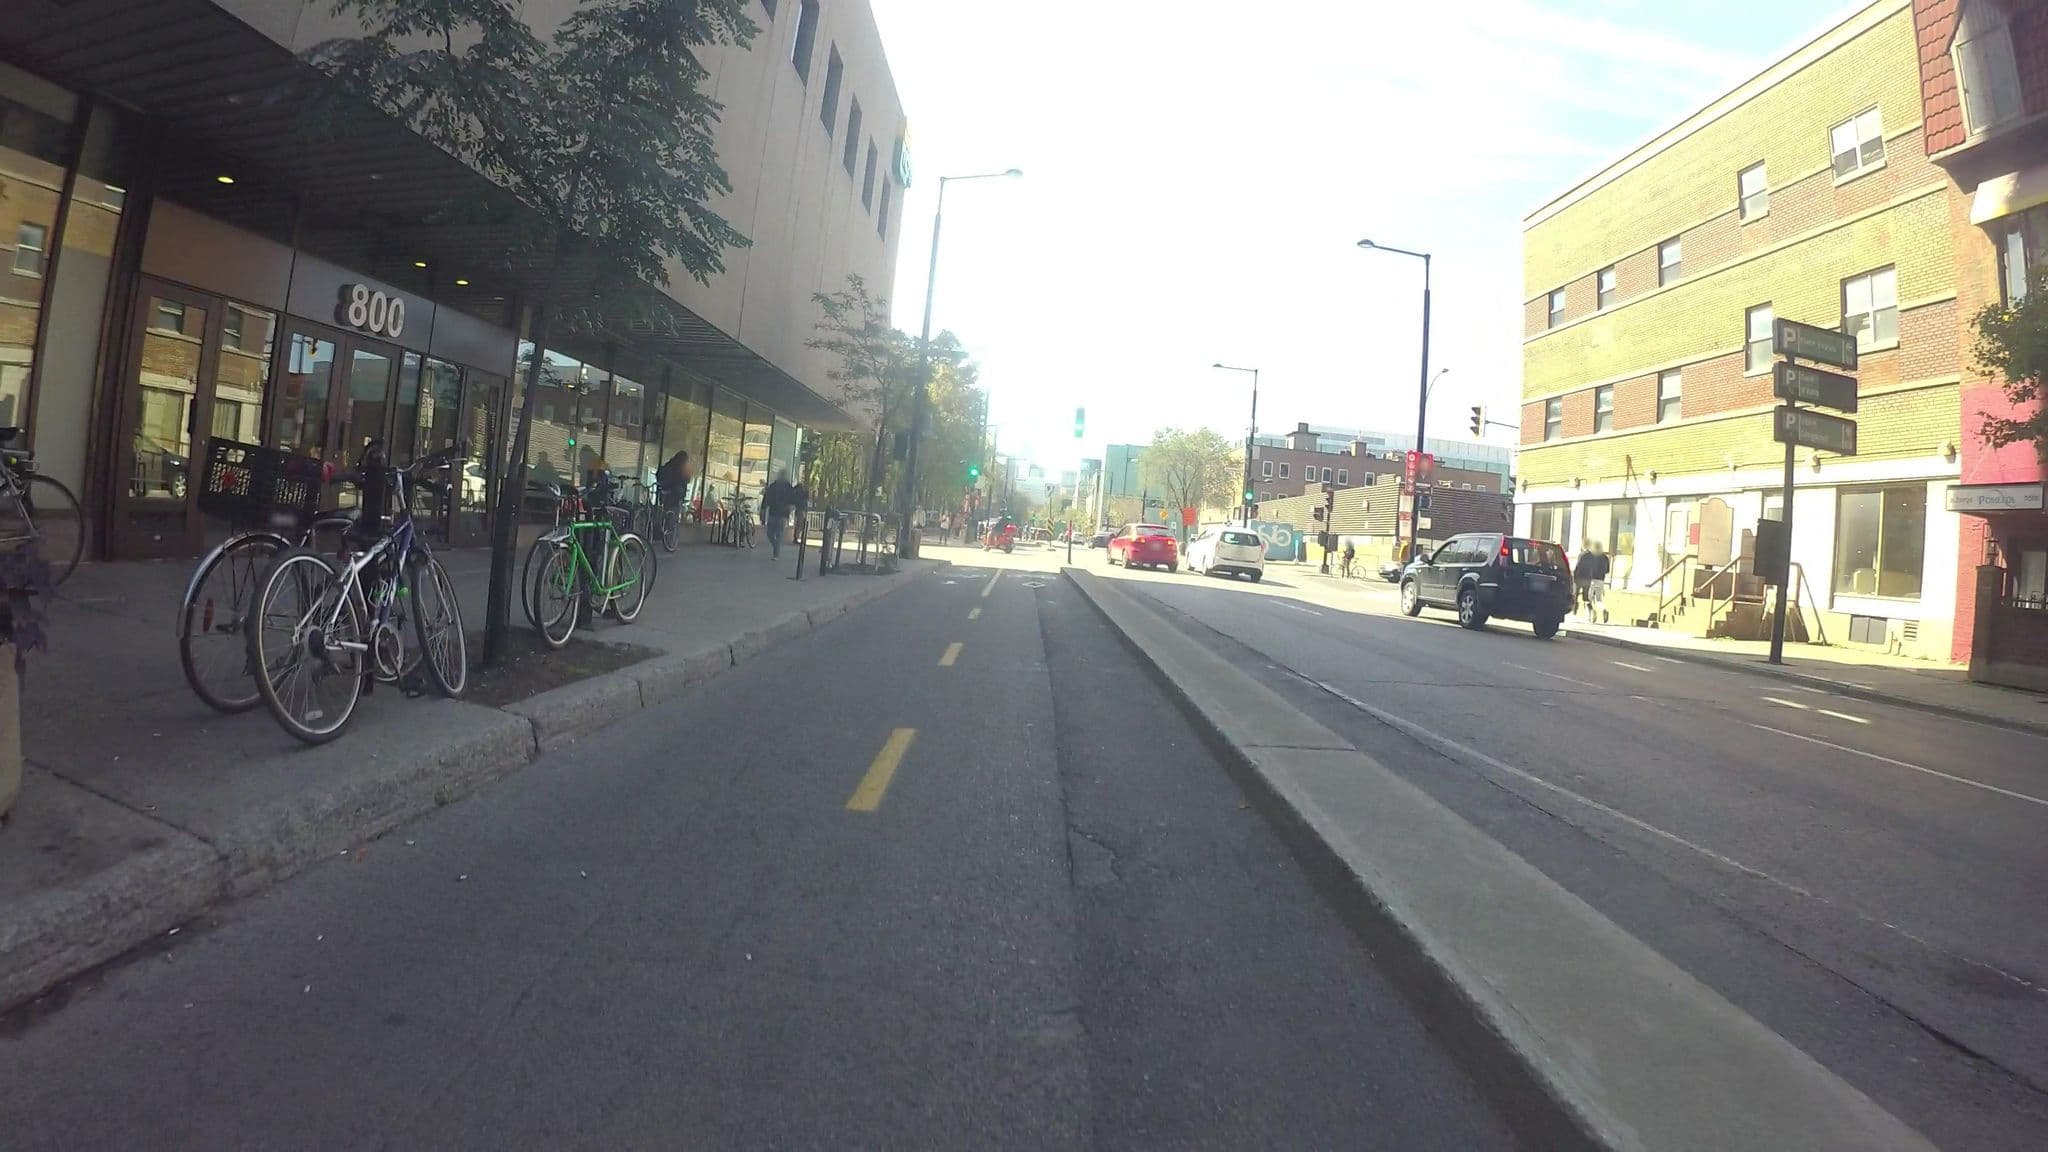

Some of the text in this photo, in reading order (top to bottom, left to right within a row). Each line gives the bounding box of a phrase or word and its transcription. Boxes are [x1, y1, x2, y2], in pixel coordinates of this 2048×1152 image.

[348, 283, 405, 338] 800
[1783, 327, 1796, 349] P
[1785, 370, 1796, 385] P
[1785, 414, 1796, 430] P
